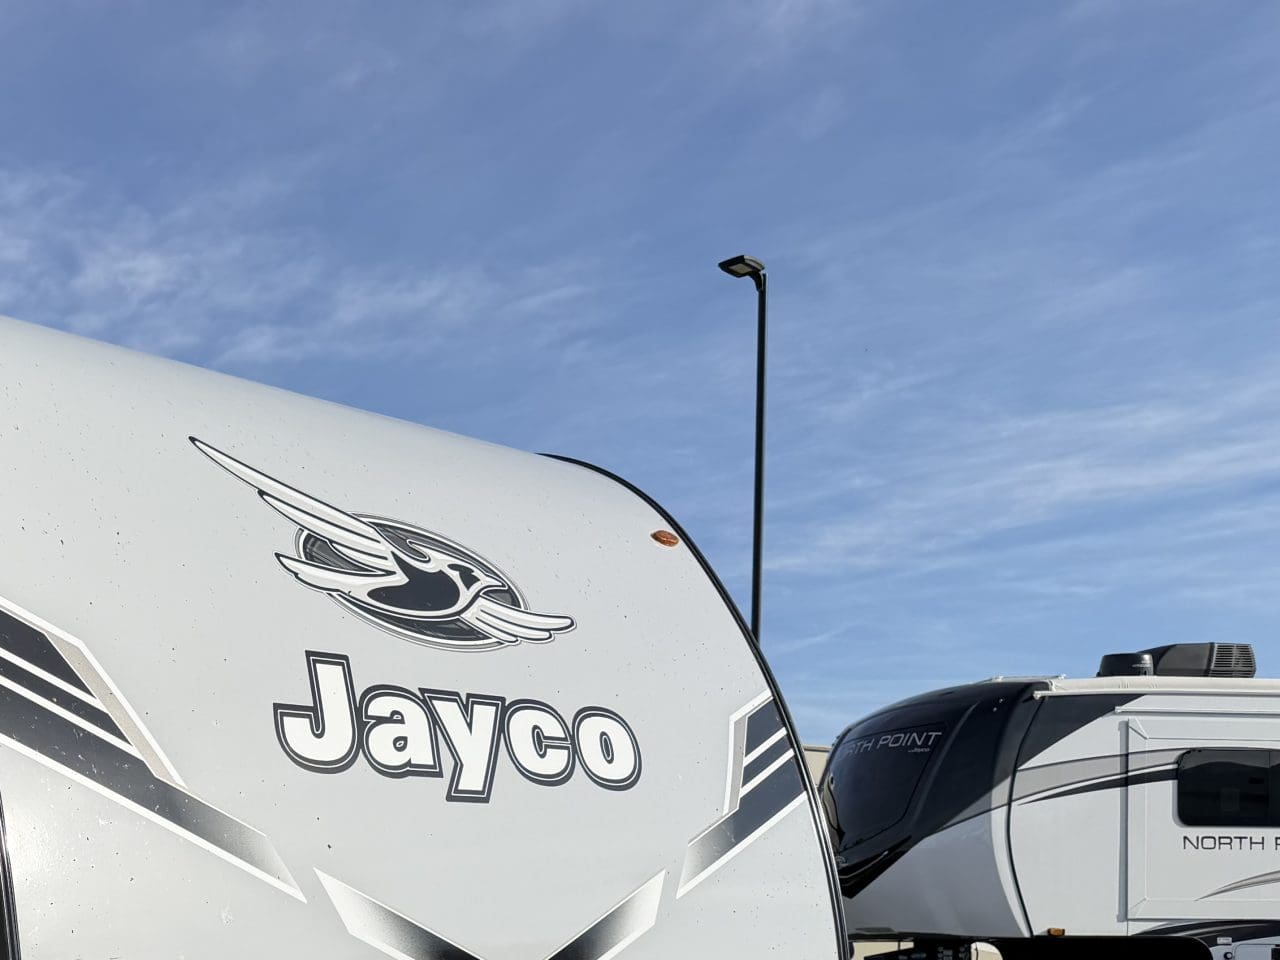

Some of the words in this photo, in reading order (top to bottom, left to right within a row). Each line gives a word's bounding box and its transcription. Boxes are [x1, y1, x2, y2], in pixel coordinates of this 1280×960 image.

[272, 649, 642, 803] Jayco
[877, 732, 942, 749] POINT
[1183, 835, 1265, 850] NORTH
